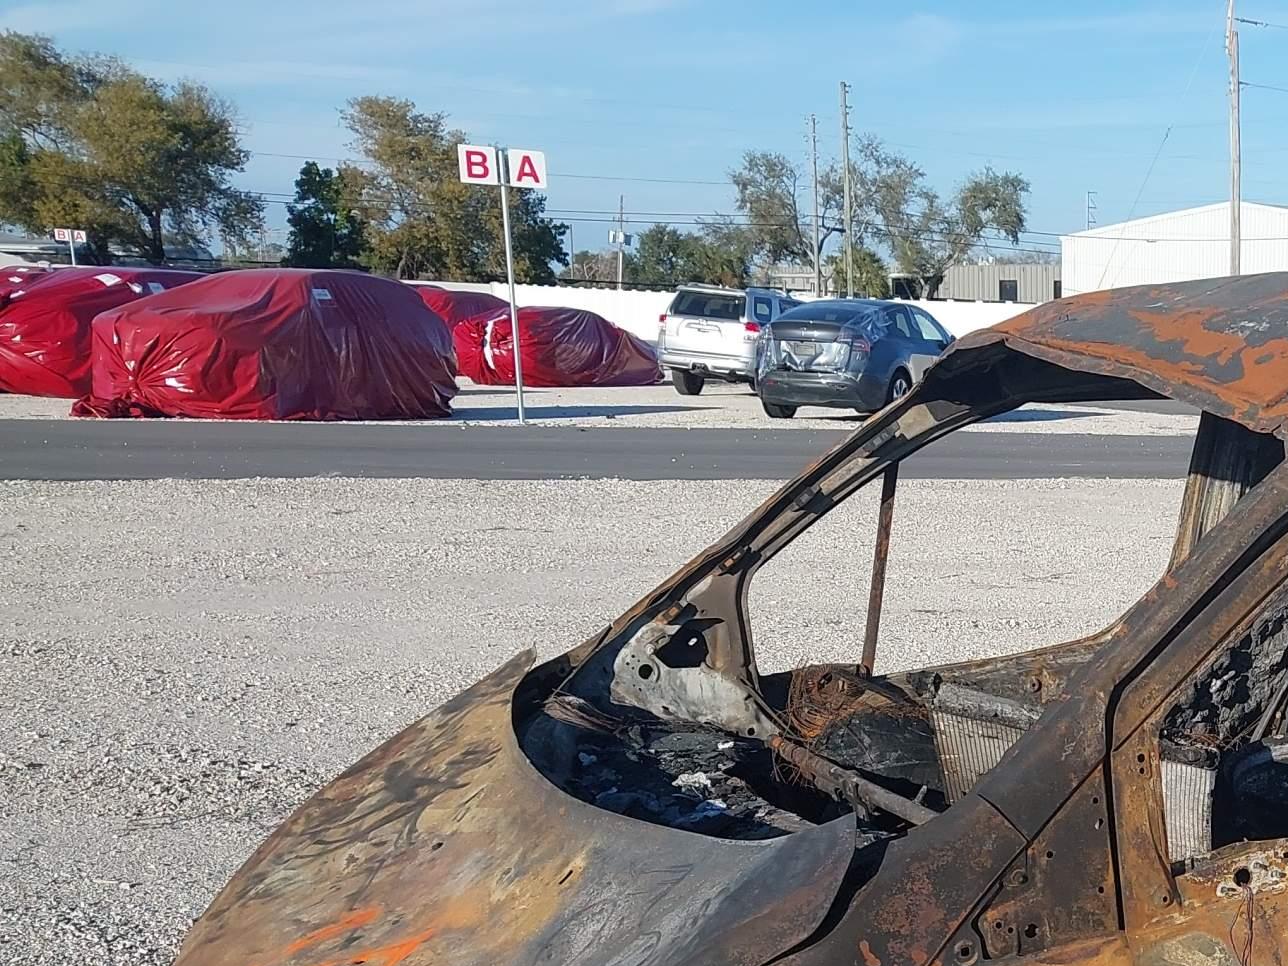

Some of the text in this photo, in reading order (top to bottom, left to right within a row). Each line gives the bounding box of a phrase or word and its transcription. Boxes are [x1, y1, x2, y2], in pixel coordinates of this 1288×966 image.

[465, 150, 489, 179] B
[516, 156, 541, 184] A
[75, 231, 84, 241] A
